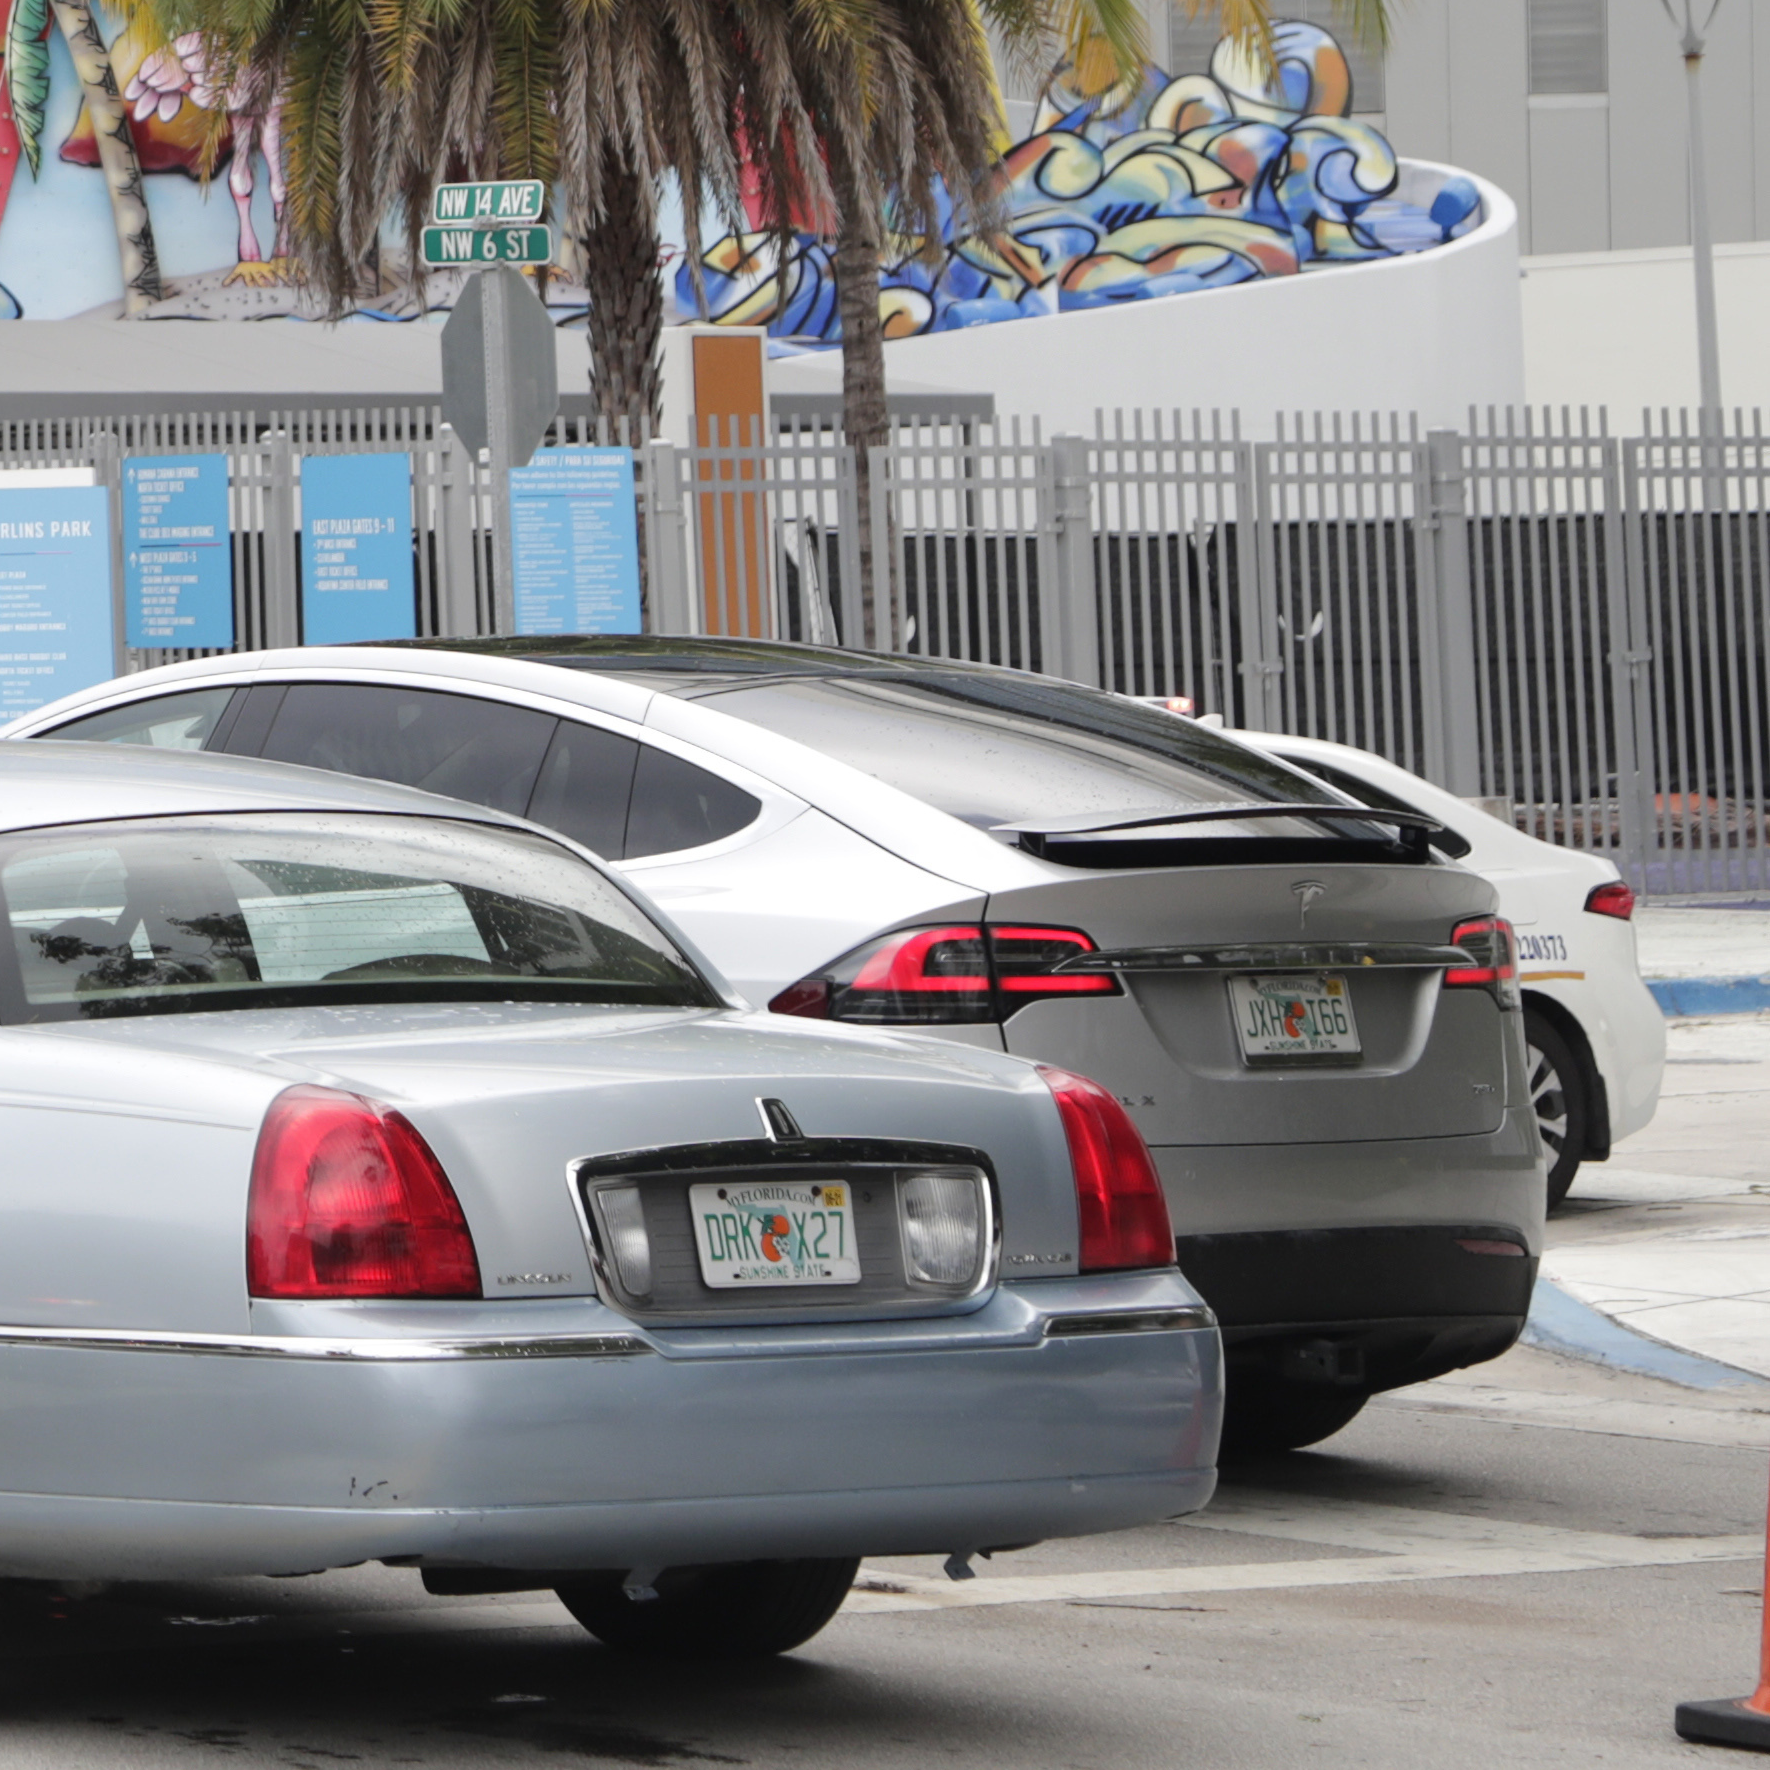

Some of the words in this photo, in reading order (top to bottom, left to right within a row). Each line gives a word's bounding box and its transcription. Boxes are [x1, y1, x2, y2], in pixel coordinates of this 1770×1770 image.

[440, 189, 468, 217] NW
[474, 187, 492, 215] 14
[498, 185, 535, 215] AVE
[440, 232, 474, 260] NW
[482, 232, 497, 259] 6
[506, 230, 531, 259] ST
[50, 520, 92, 538] PARK
[312, 519, 329, 536] EAST
[330, 519, 351, 535] PLAZA
[352, 518, 373, 535] GATES
[374, 517, 380, 534] 9
[387, 517, 395, 533] 11
[1247, 999, 1285, 1037] JXH
[726, 1187, 818, 1208] MYFLORIDA.COM
[704, 1212, 760, 1262] DRK
[792, 1210, 844, 1260] X27
[739, 1266, 790, 1279] SUNSHINE
[793, 1264, 826, 1278] STATE
